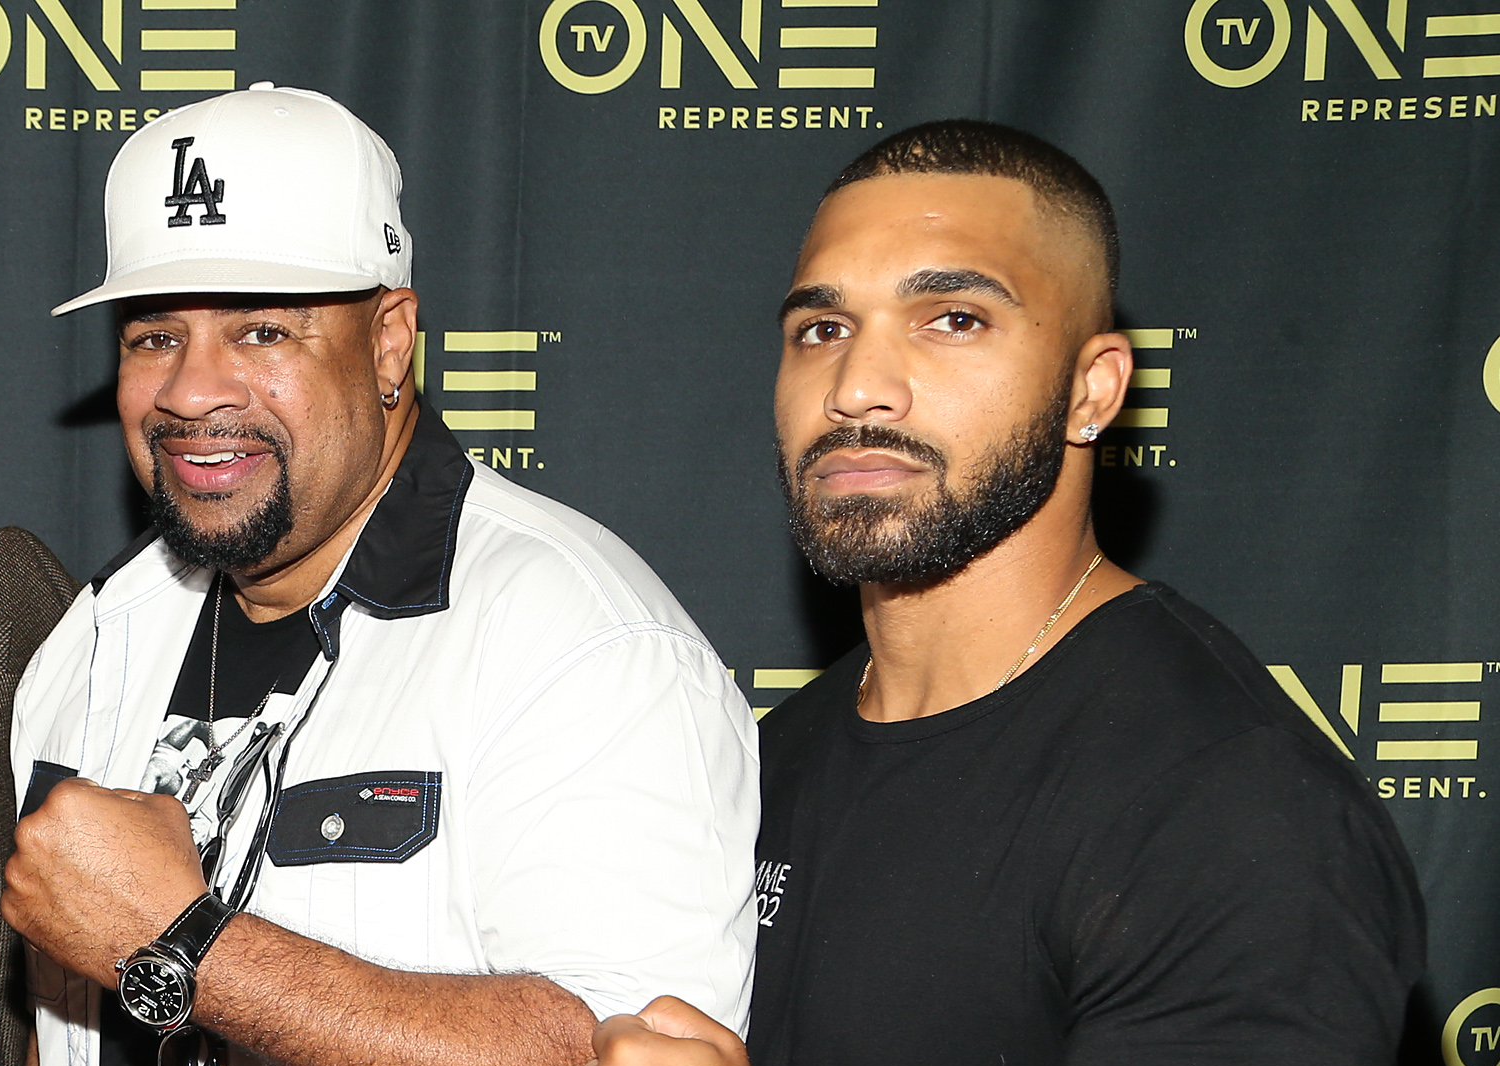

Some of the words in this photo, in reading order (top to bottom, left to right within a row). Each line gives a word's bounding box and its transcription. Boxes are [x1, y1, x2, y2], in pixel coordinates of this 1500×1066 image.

[570, 24, 615, 52] TV
[1216, 17, 1260, 45] TV
[539, 0, 878, 95] ONE
[659, 106, 883, 129] REPRESENT.
[1302, 94, 1498, 121] REPRESEN
[165, 136, 226, 228] LA
[1366, 776, 1487, 799] SENT.
